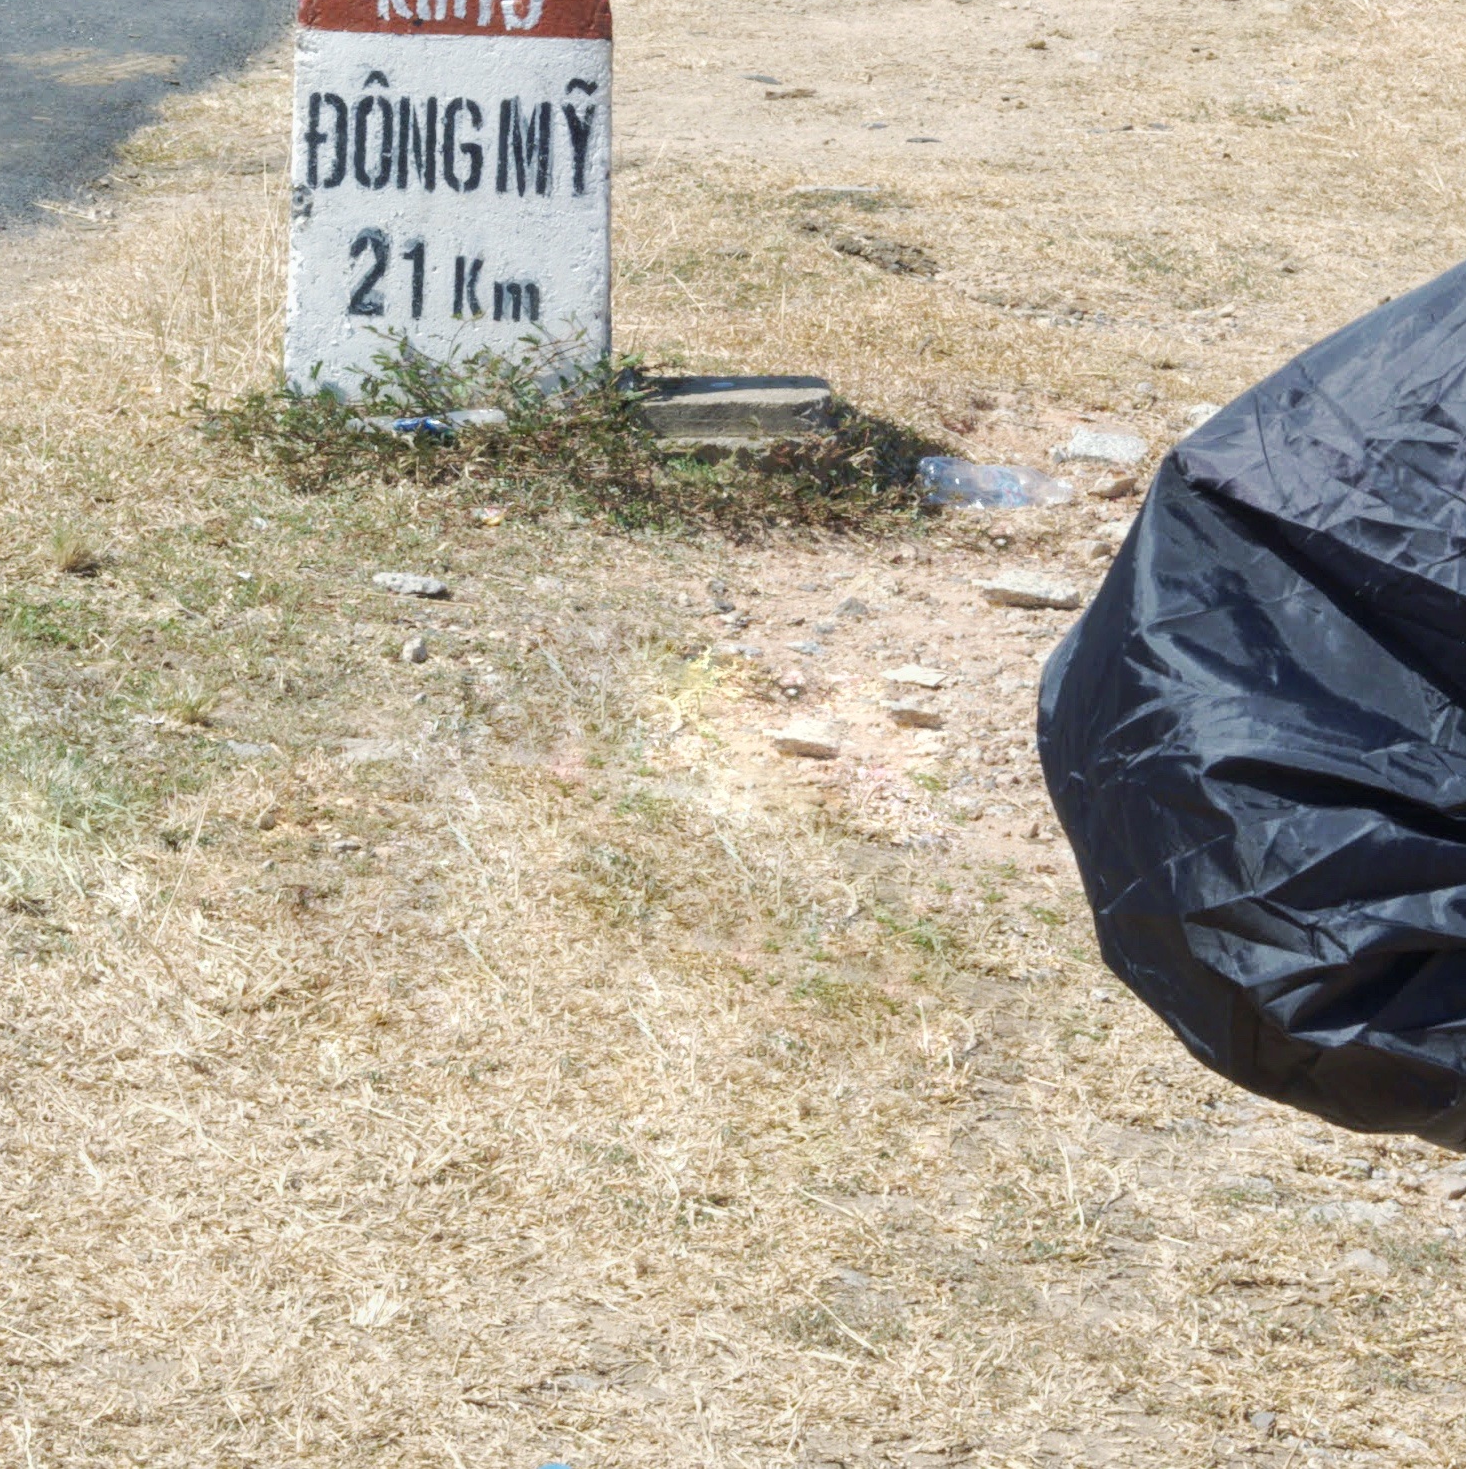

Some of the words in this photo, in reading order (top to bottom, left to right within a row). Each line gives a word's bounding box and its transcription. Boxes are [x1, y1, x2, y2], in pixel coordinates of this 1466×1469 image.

[304, 70, 484, 193] ĐÔNG
[495, 77, 598, 198] MỸ
[347, 228, 426, 321] 21
[451, 255, 541, 322] Km
